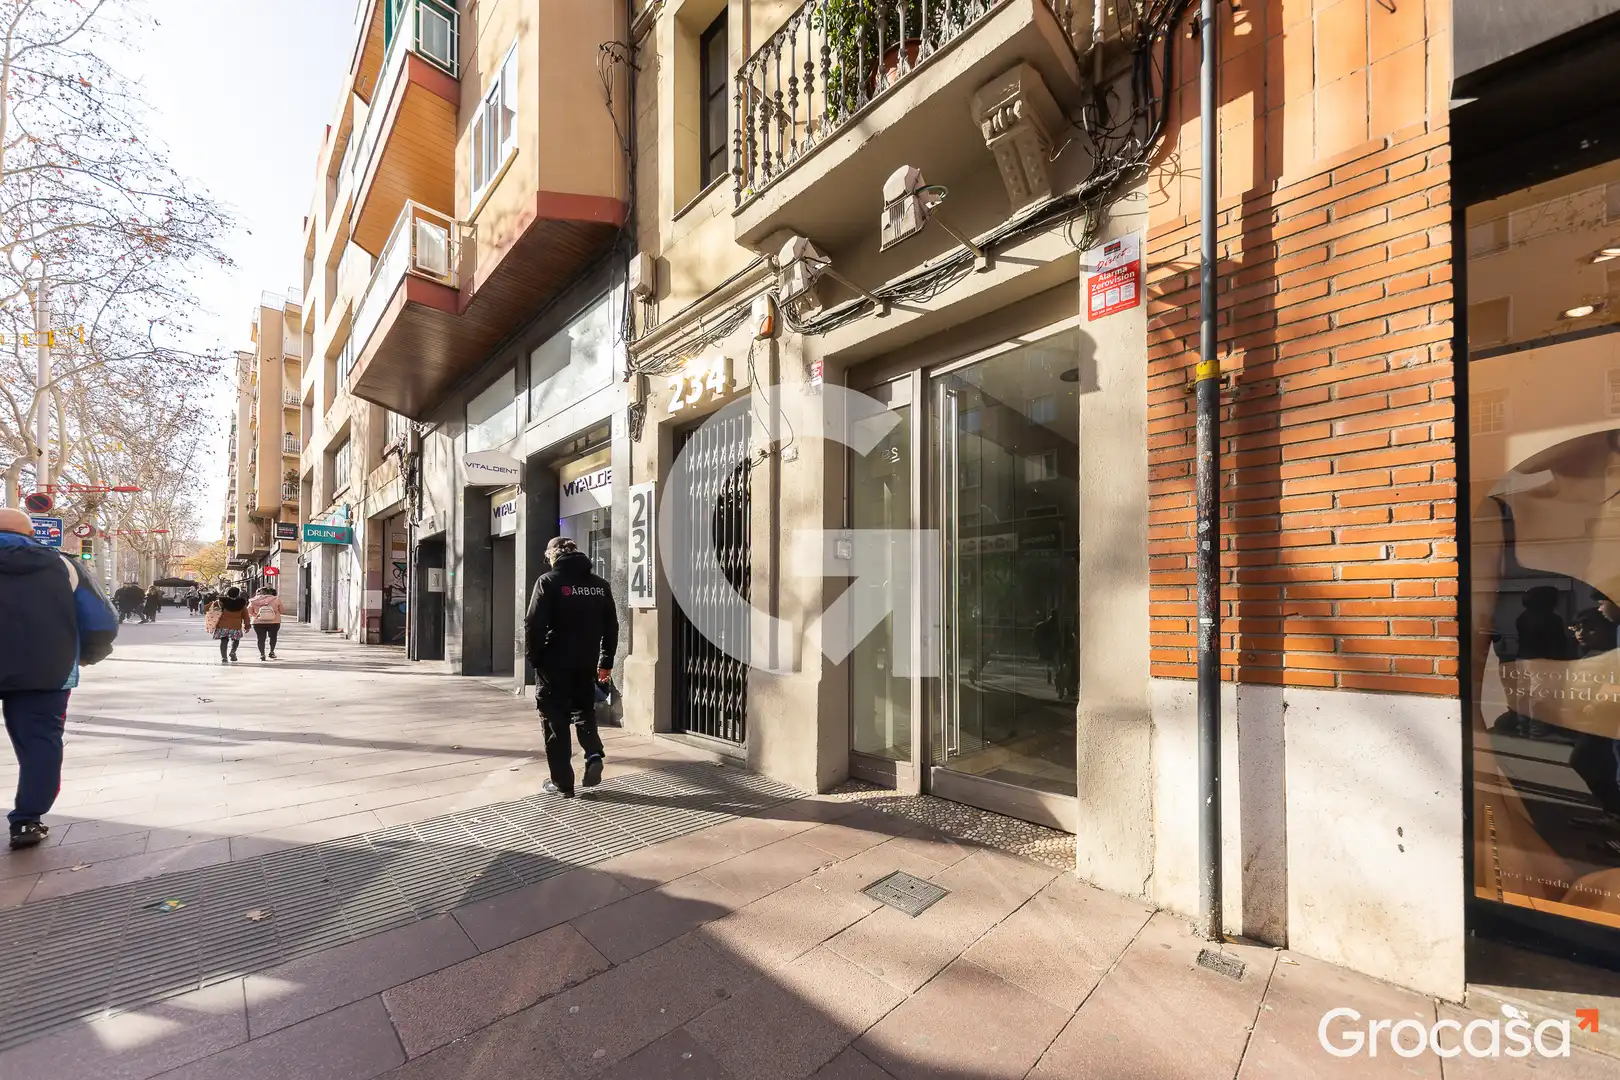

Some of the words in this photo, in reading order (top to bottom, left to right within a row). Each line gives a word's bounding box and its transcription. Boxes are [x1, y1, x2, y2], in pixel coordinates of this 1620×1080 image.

[1098, 266, 1128, 282] Alarma
[667, 355, 726, 413] 234
[465, 461, 518, 475] VITALDENT
[493, 501, 516, 519] VITAL
[307, 529, 336, 538] DRUNI
[1537, 877, 1570, 890] cada
[1575, 883, 1611, 898] dona
